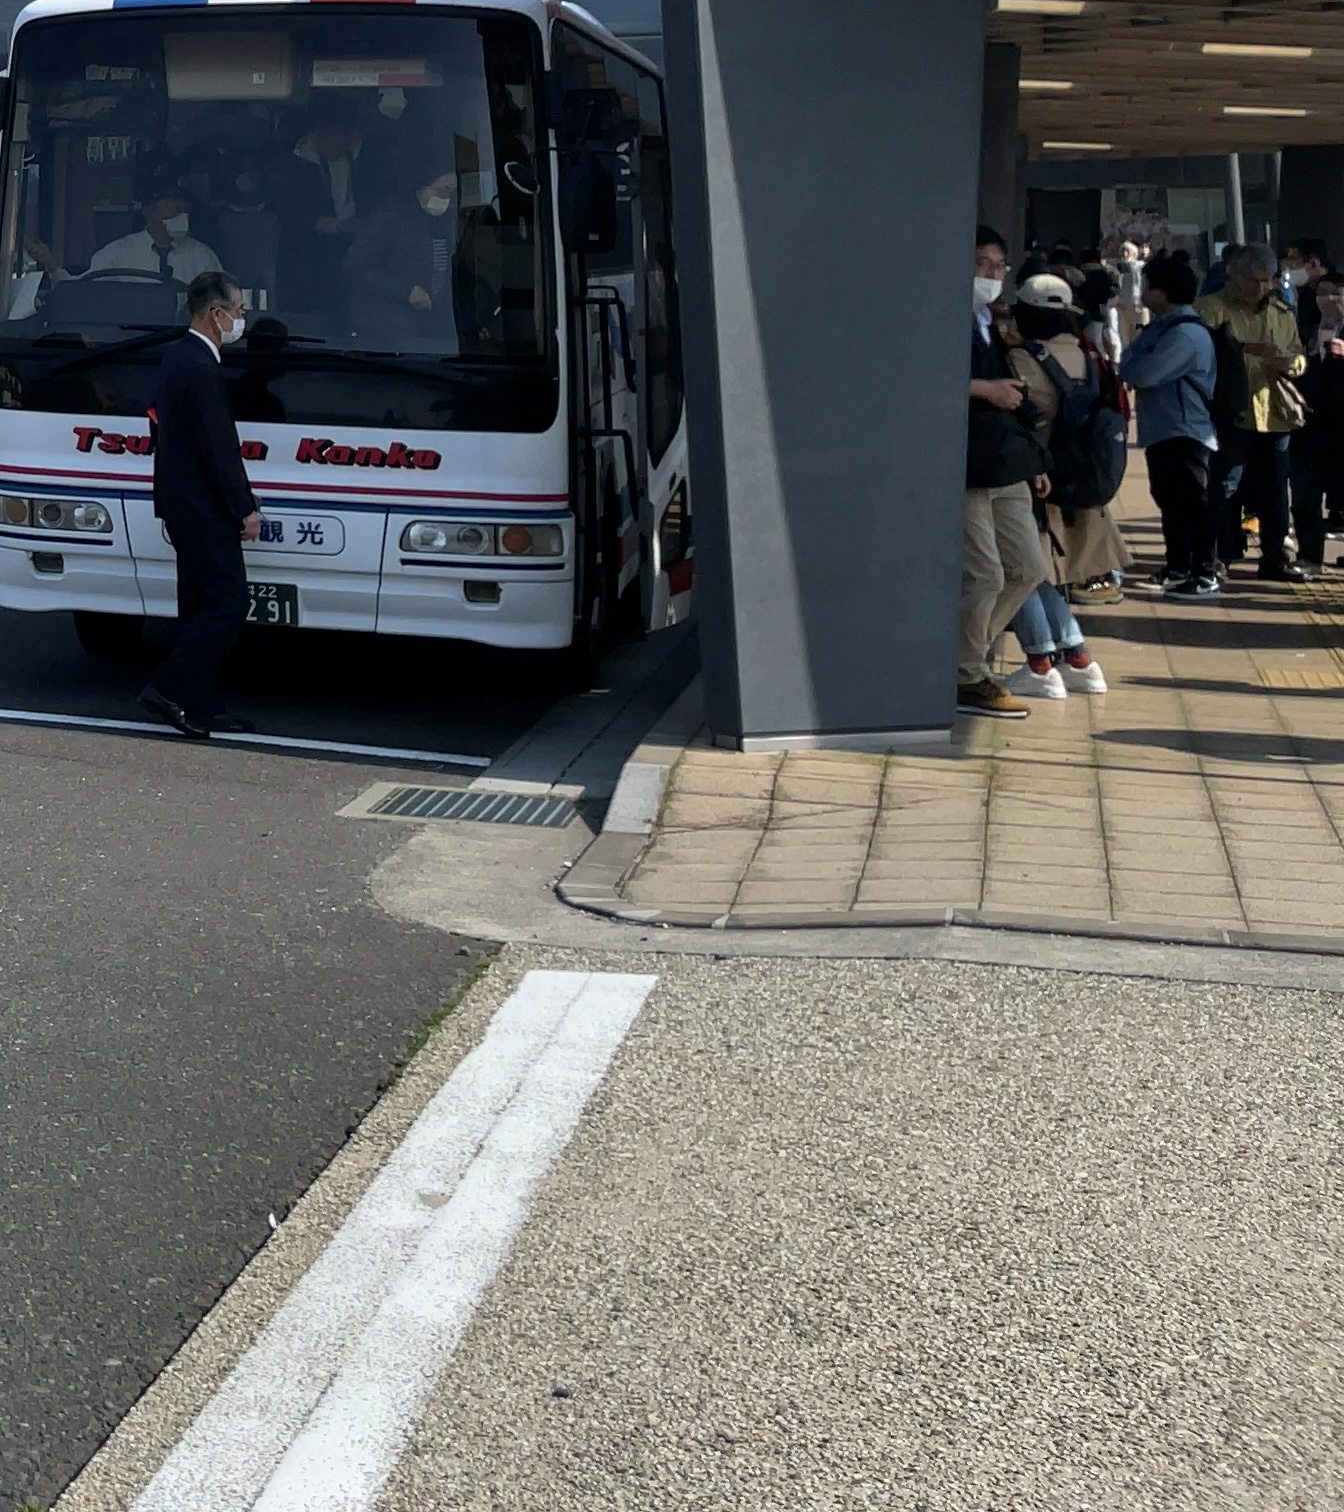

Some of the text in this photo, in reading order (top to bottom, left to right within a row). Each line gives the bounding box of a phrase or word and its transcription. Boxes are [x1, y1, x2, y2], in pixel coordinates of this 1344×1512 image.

[73, 426, 442, 471] Tsua Kanko
[259, 519, 324, 546] 観光
